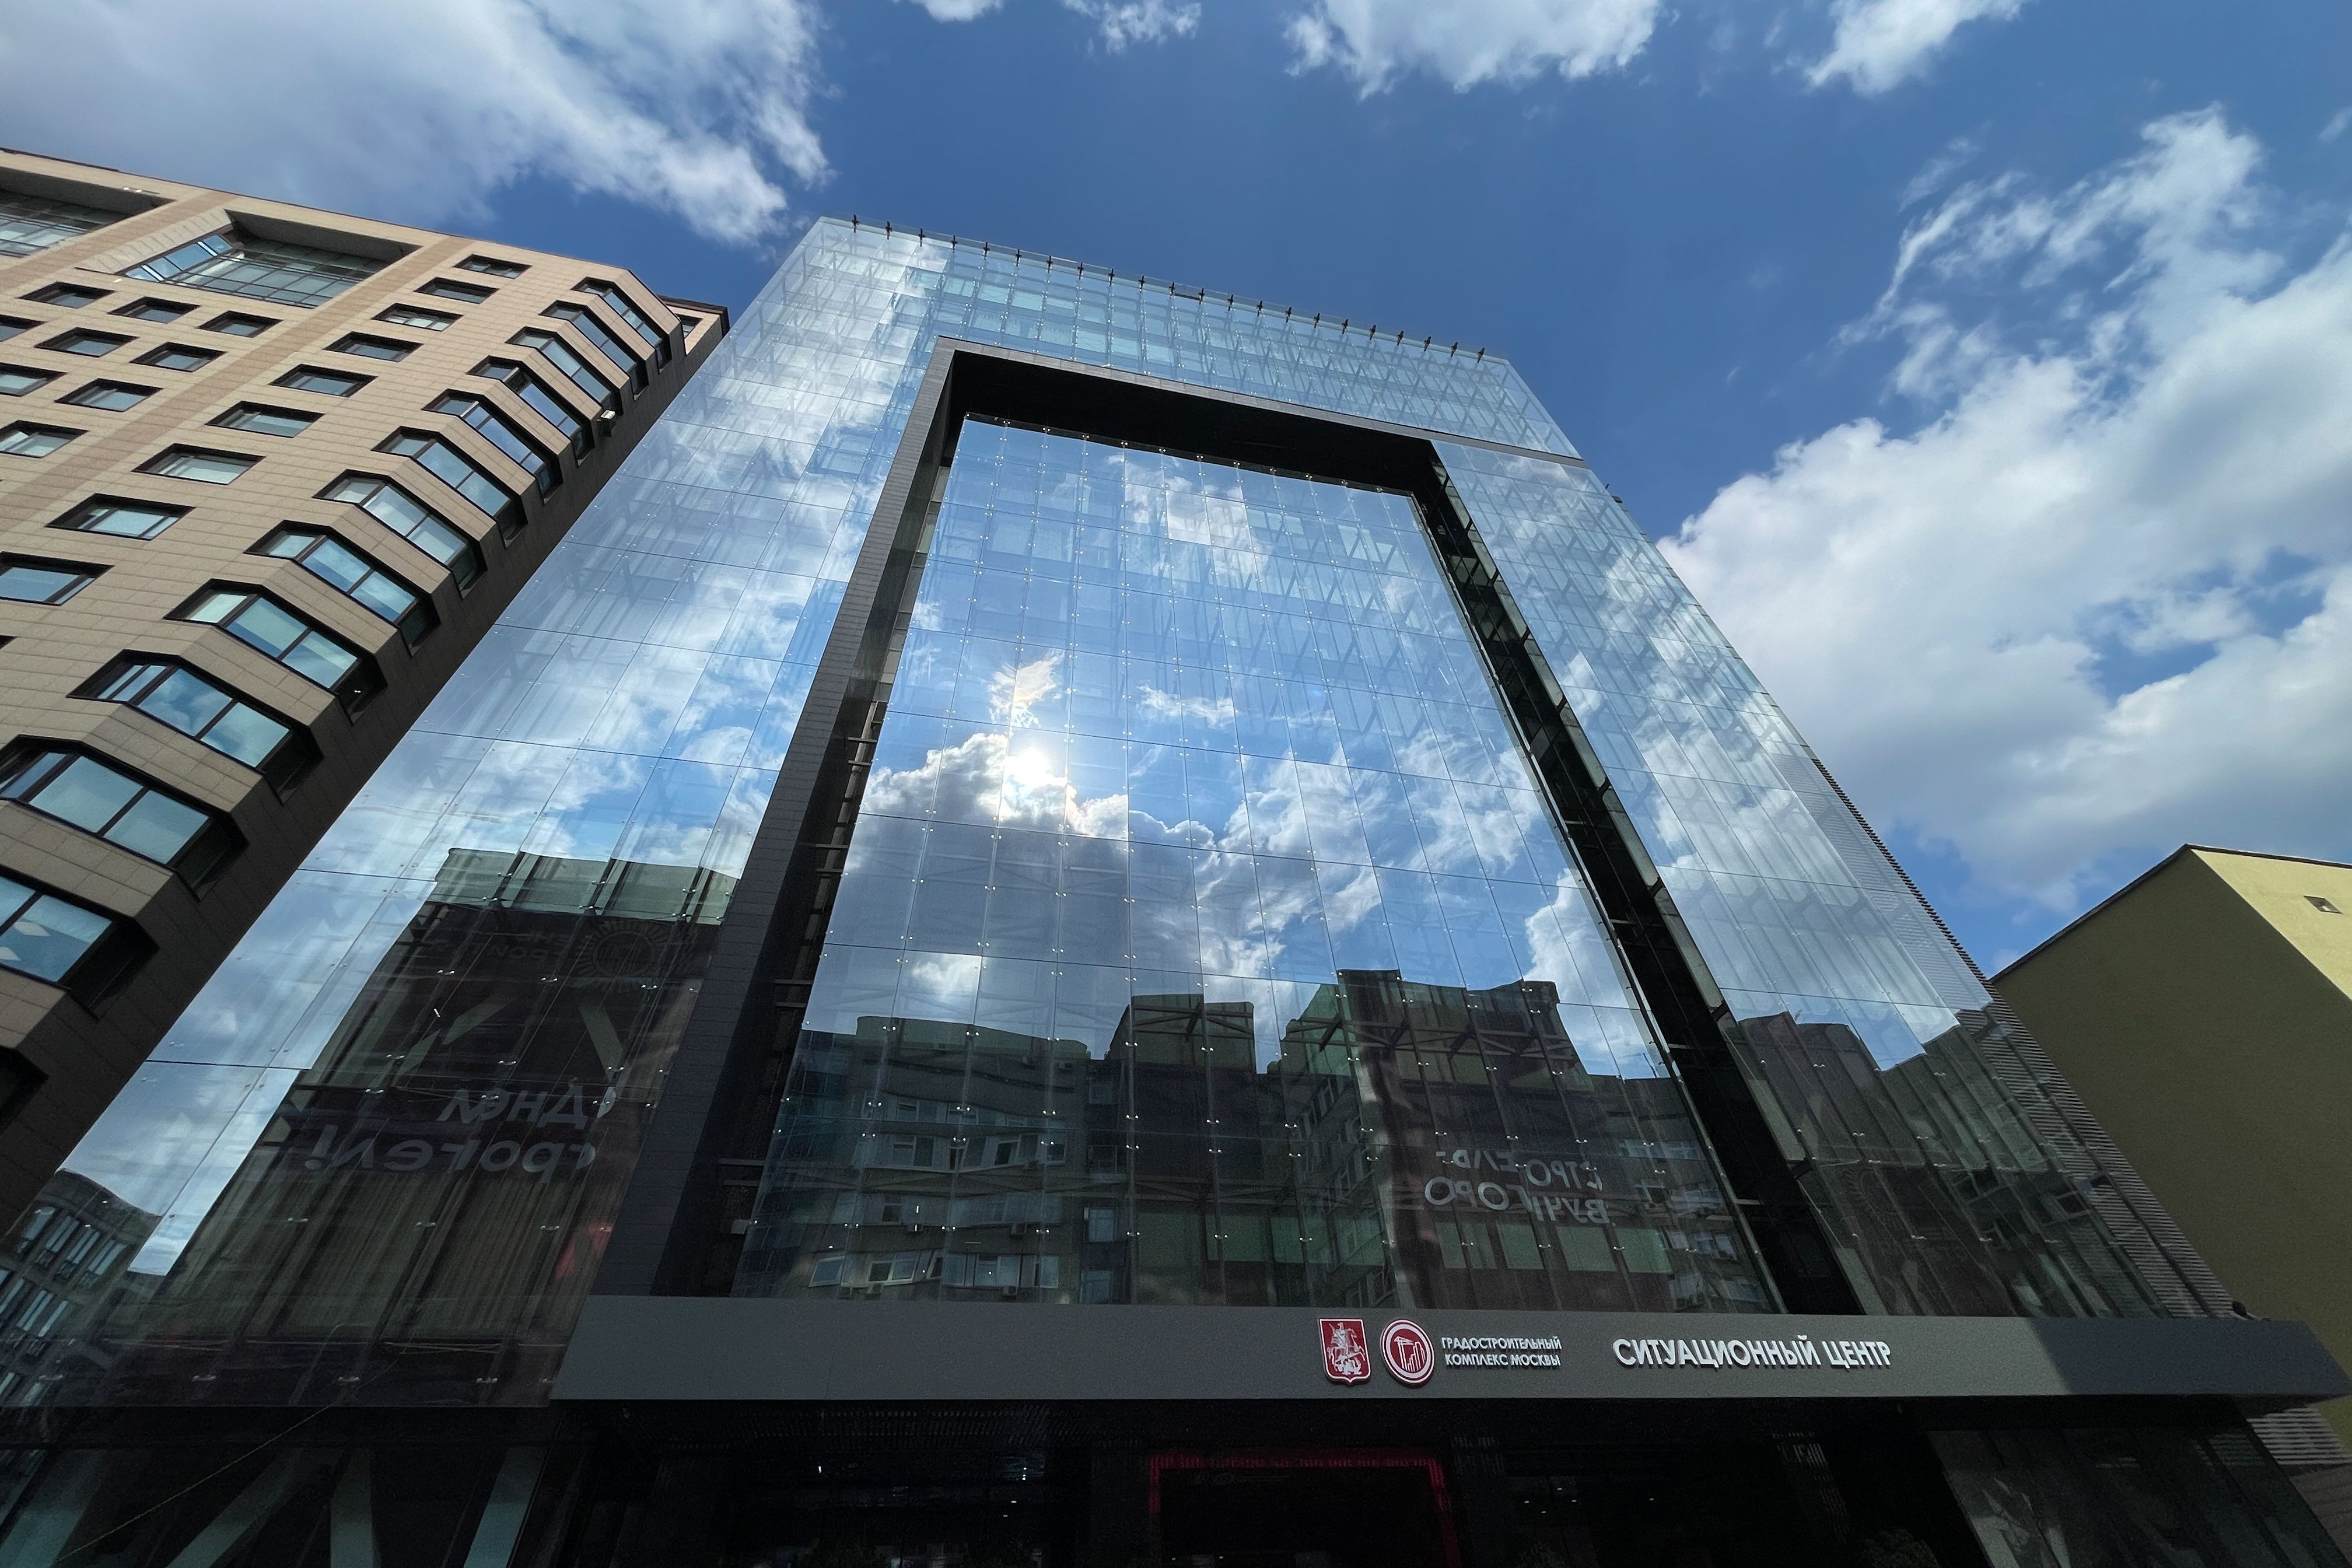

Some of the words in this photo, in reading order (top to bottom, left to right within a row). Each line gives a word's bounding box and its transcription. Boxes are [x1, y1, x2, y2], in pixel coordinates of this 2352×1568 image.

[1441, 1336, 1562, 1350] ГРАДОСТРОИТЕЛЬНЫЙ
[1612, 1335, 1822, 1368] СИТУАЦИОННЫЙ
[1822, 1341, 1891, 1368] ЦЕНТР
[1445, 1353, 1508, 1366] КОМПЛЕКС
[1511, 1353, 1561, 1366] МОСКВЫ
